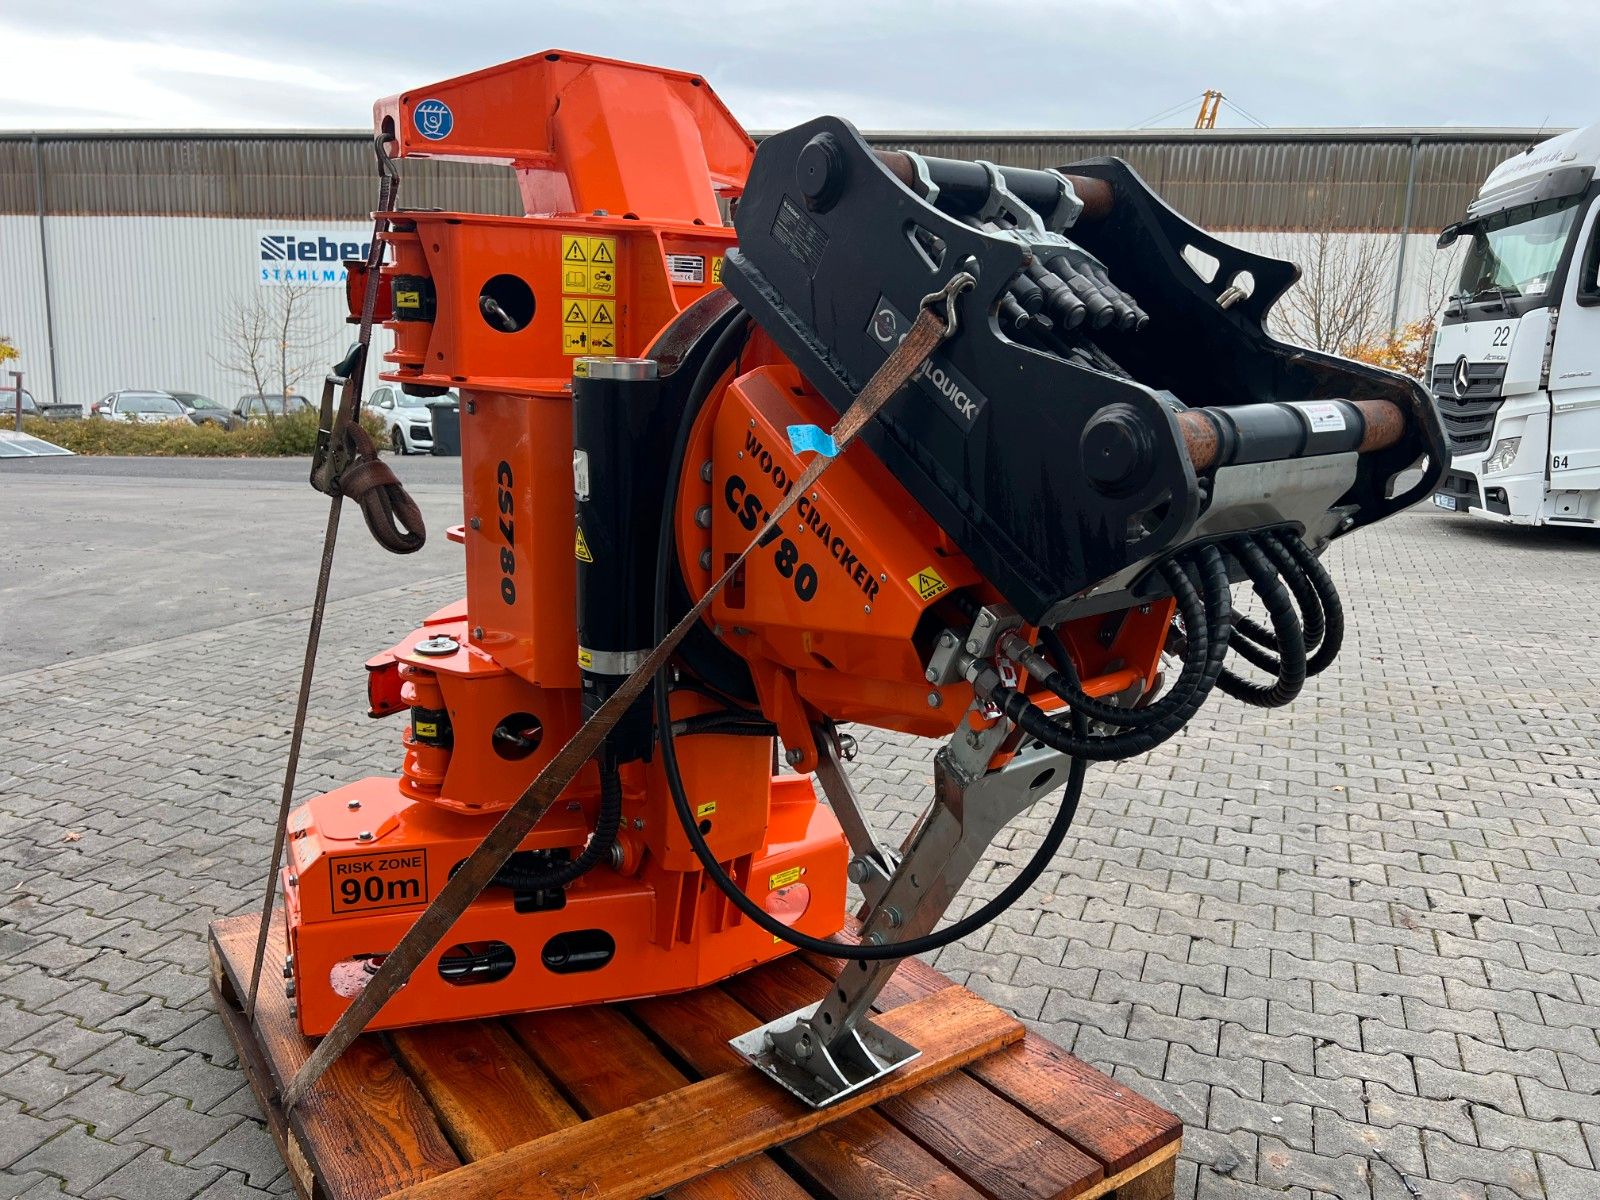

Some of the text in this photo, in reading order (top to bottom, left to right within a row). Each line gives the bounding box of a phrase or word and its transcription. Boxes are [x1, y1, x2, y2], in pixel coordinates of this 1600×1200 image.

[1492, 326, 1510, 347] 22
[898, 333, 976, 420] ILQUICK
[1552, 455, 1569, 469] 64
[497, 460, 516, 606] CS780
[724, 474, 818, 602] CS780
[336, 856, 422, 876] RISK ZONE
[340, 875, 420, 905] 90m
